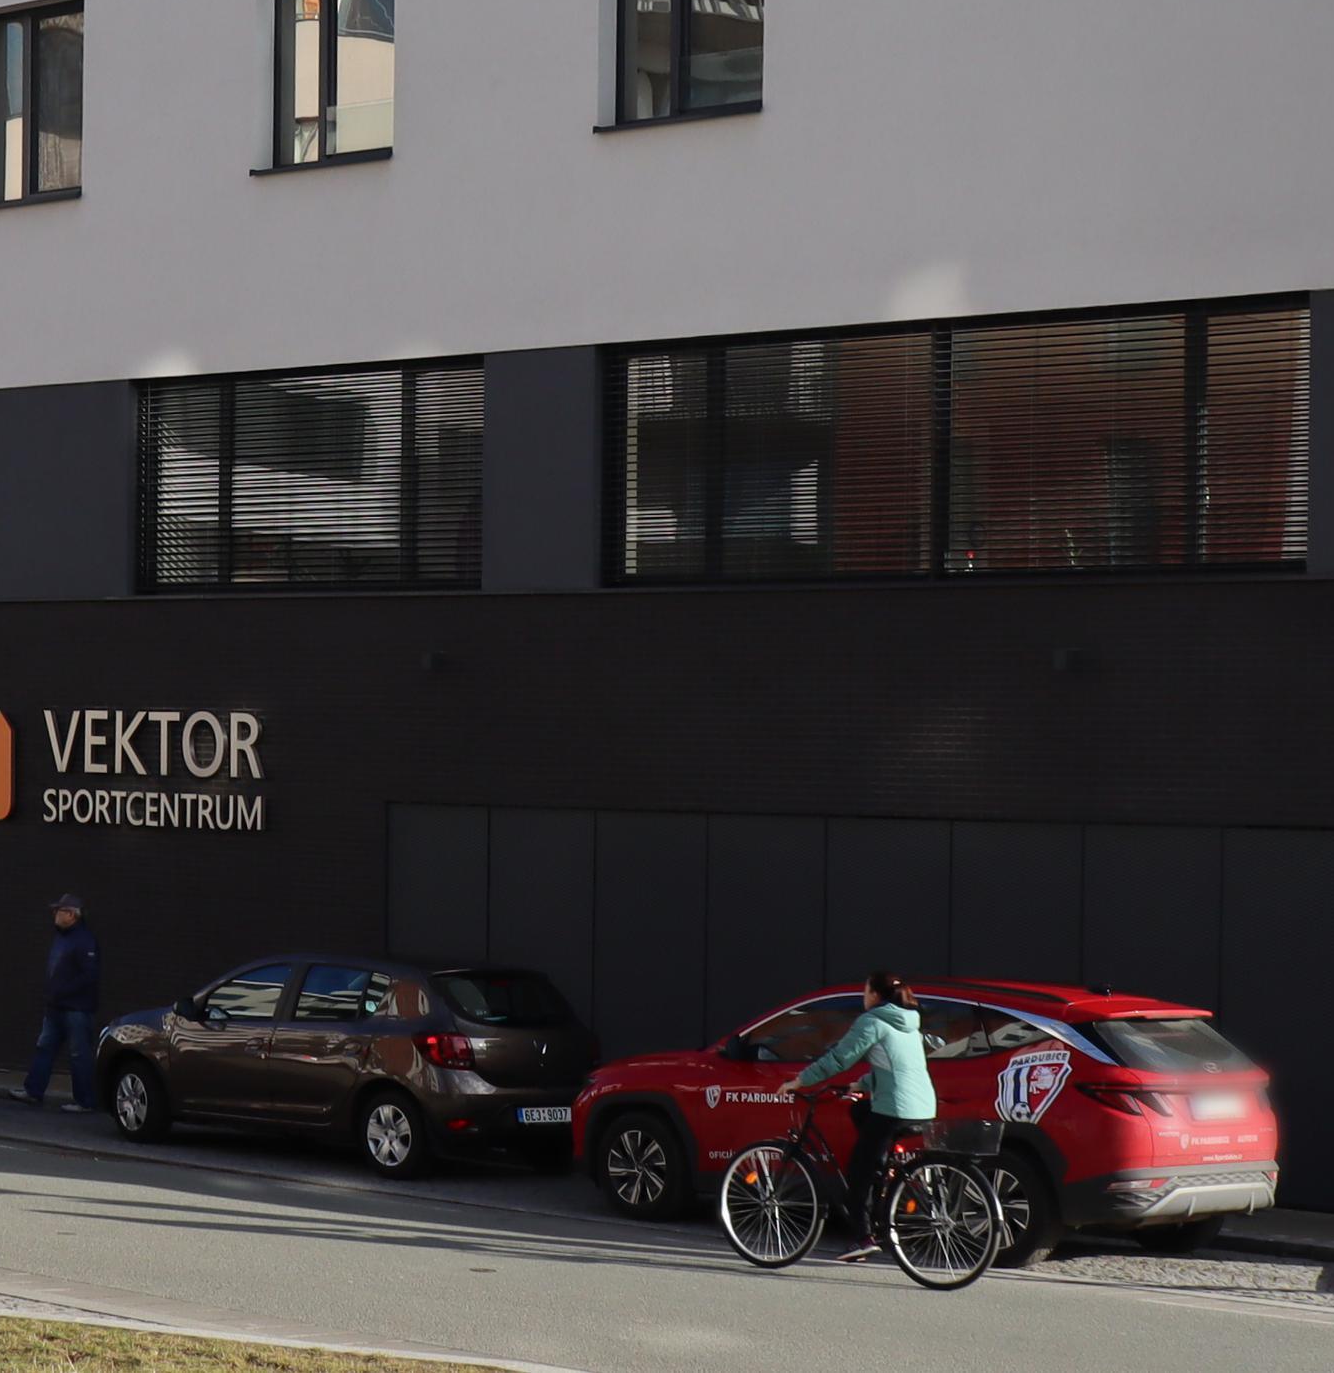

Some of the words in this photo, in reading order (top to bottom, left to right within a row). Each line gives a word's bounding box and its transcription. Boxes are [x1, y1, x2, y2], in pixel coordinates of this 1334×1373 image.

[42, 708, 264, 779] VEKTOR
[42, 787, 264, 831] SPORTCENTRUM
[1011, 1052, 1068, 1068] PARDUBICE
[725, 1092, 740, 1102] FK
[524, 1109, 542, 1121] 6E3
[547, 1108, 568, 1121] 9037
